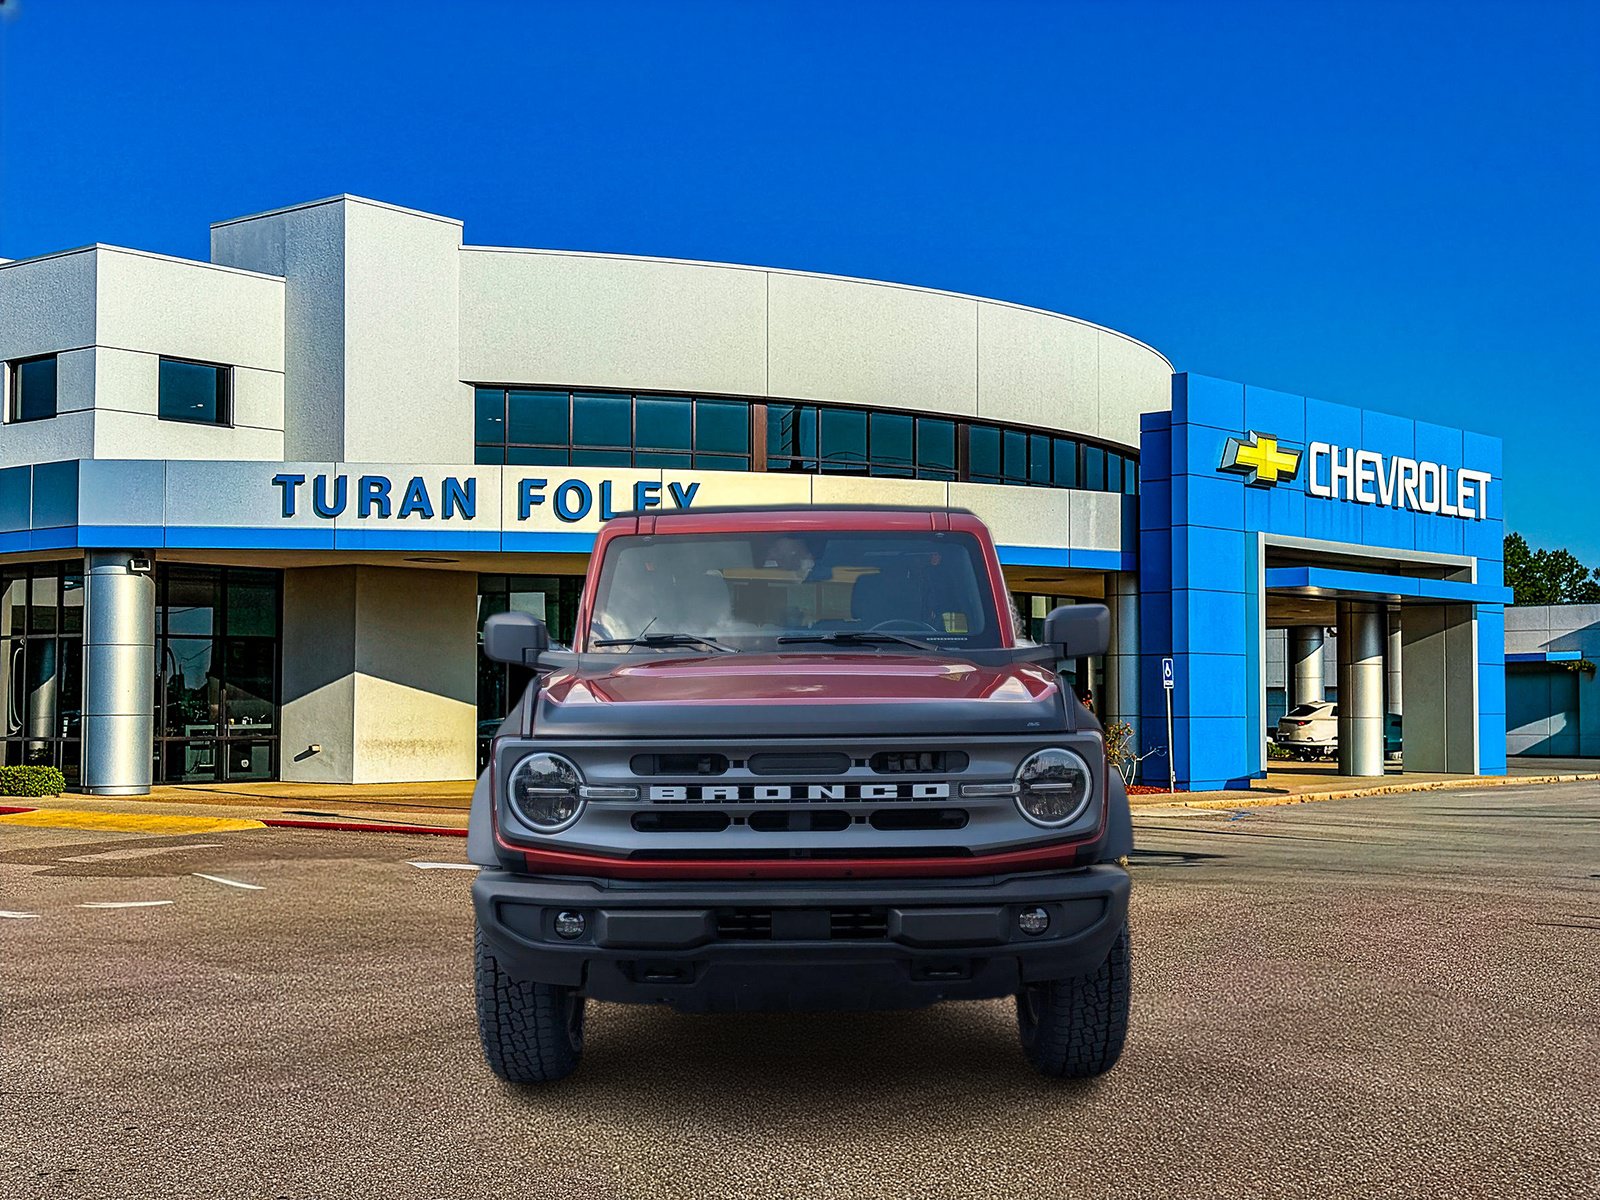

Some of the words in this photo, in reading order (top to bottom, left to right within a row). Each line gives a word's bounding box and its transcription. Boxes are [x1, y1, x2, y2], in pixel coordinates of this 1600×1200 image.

[272, 474, 476, 520] TURAN
[518, 478, 700, 522] FOLEY
[1308, 441, 1492, 520] CHEVROLET
[650, 784, 950, 800] BRONCO
